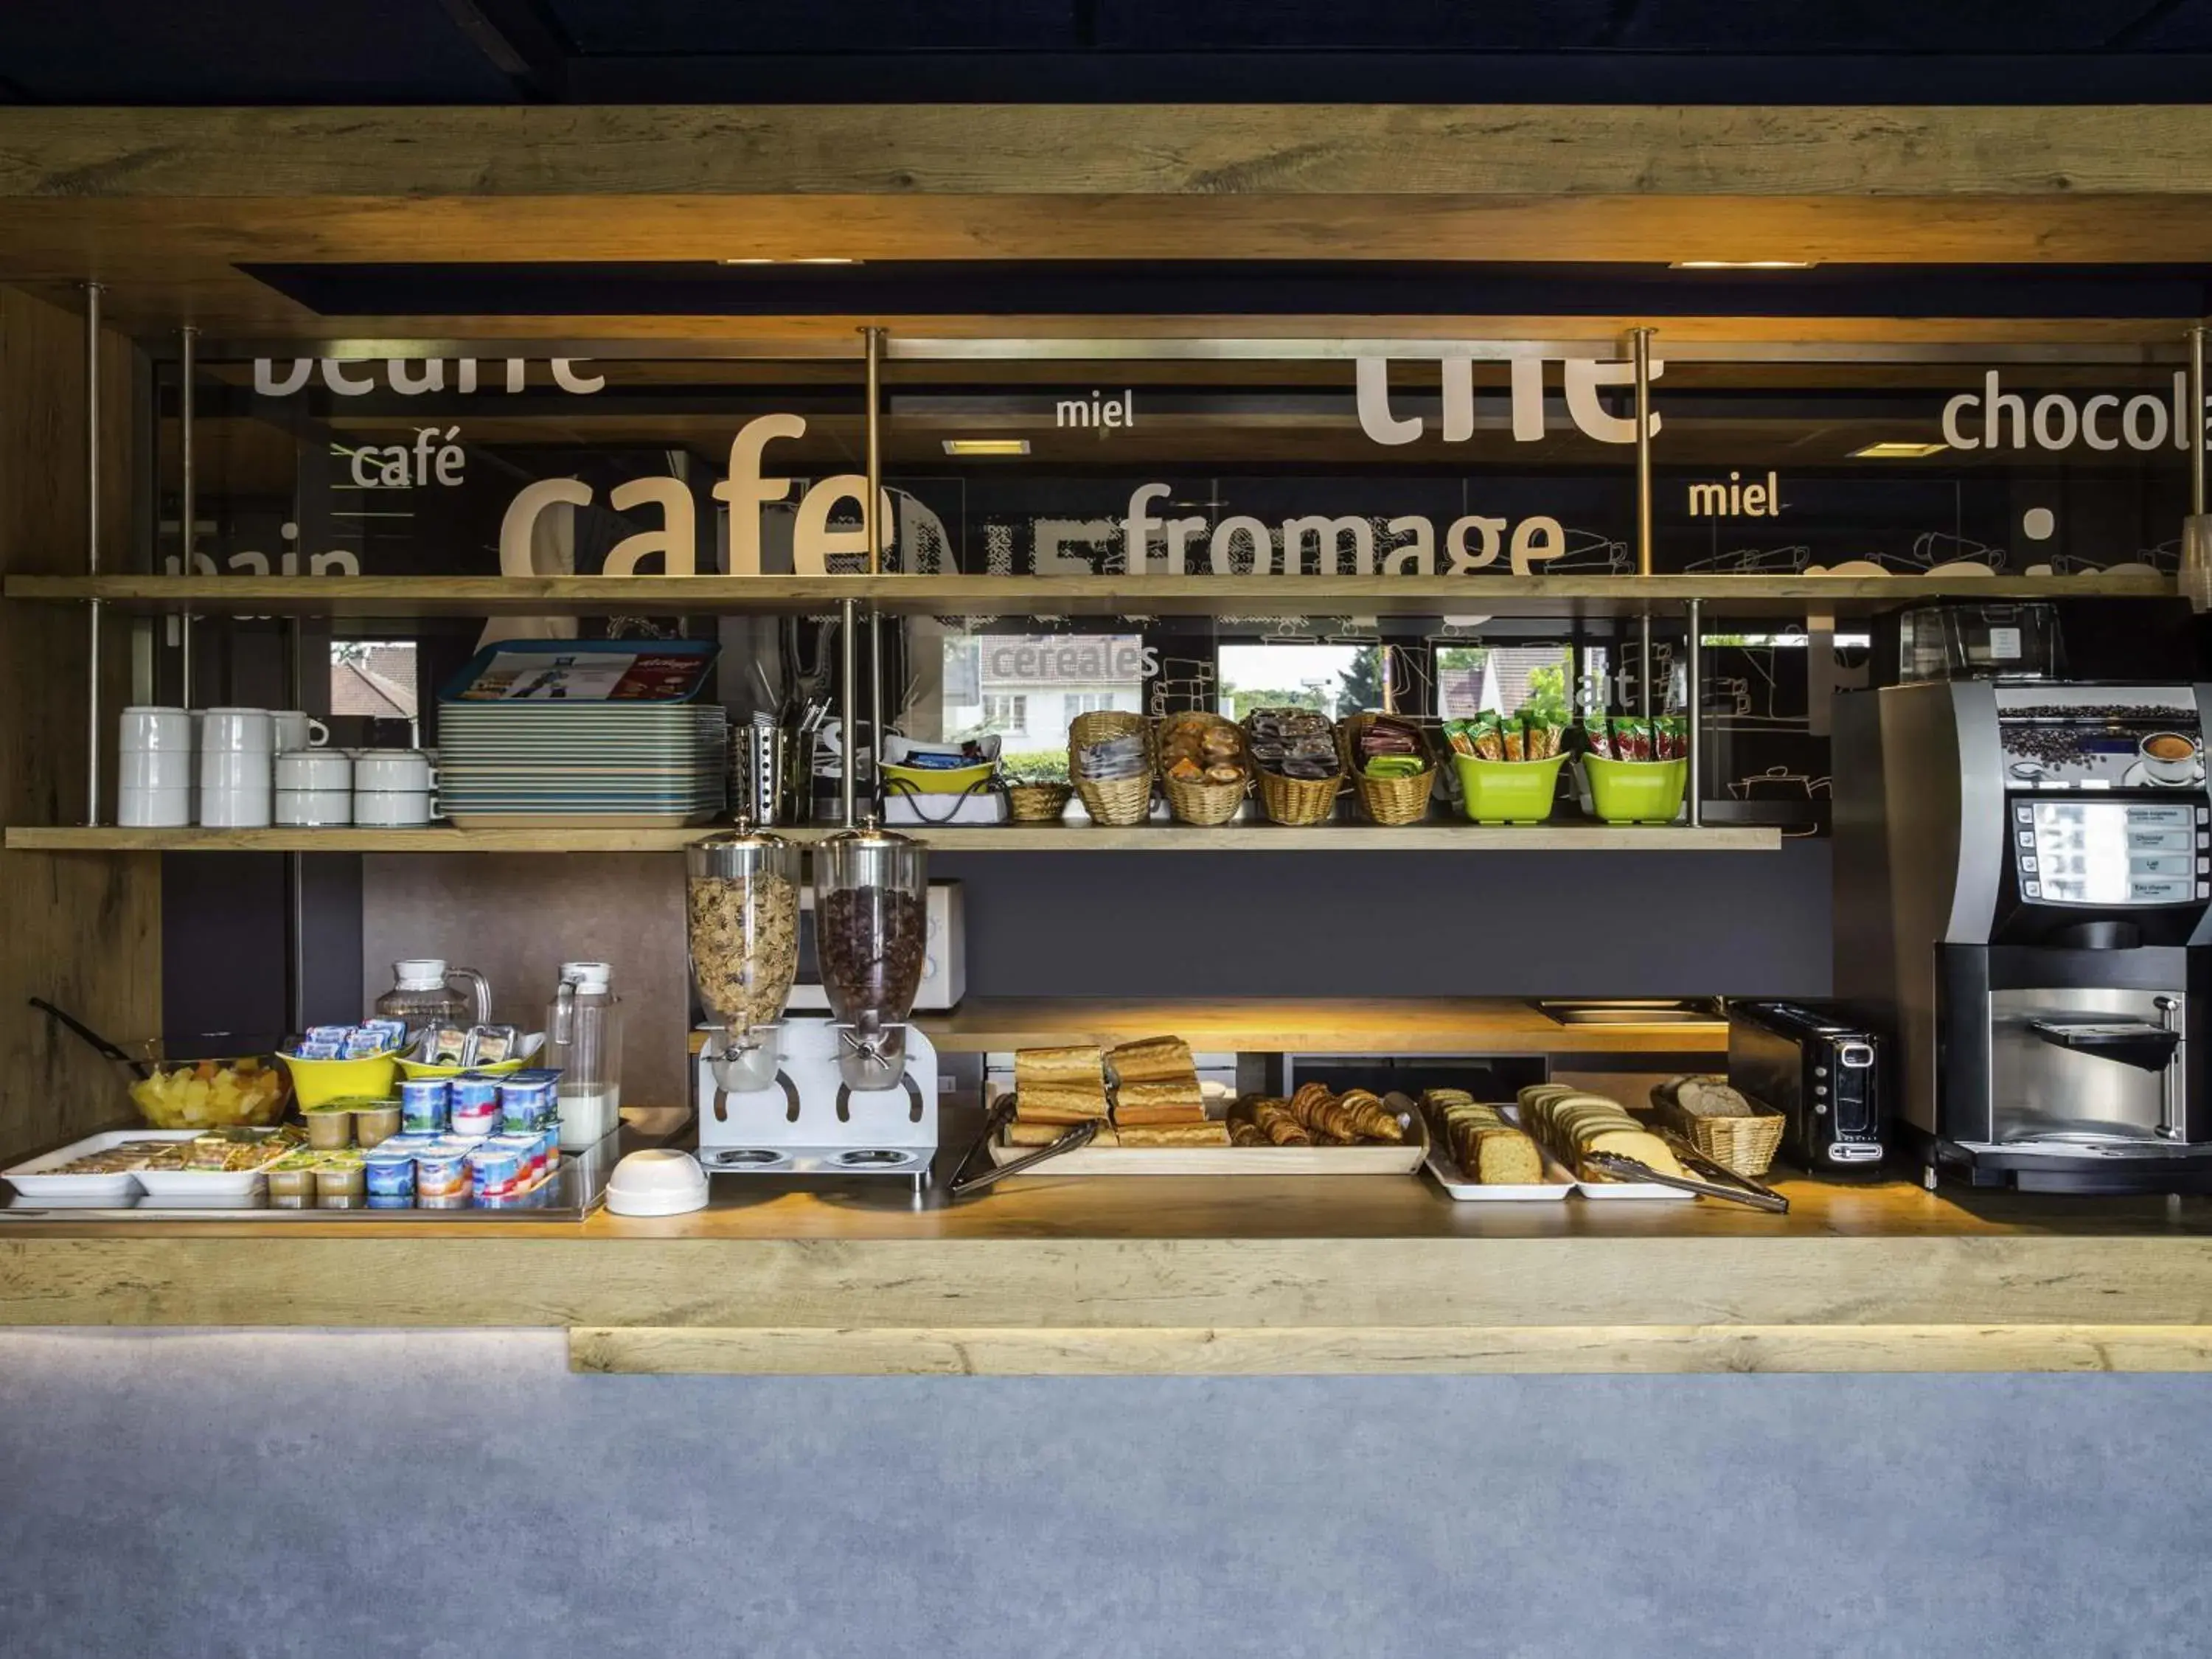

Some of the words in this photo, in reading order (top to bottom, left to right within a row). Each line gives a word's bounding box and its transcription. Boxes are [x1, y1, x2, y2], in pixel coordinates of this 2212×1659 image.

[1057, 389, 1133, 427] miel
[1942, 370, 2212, 451] chocol
[351, 425, 465, 487] café
[1688, 471, 1779, 517] miel
[1119, 483, 1565, 625] fromage
